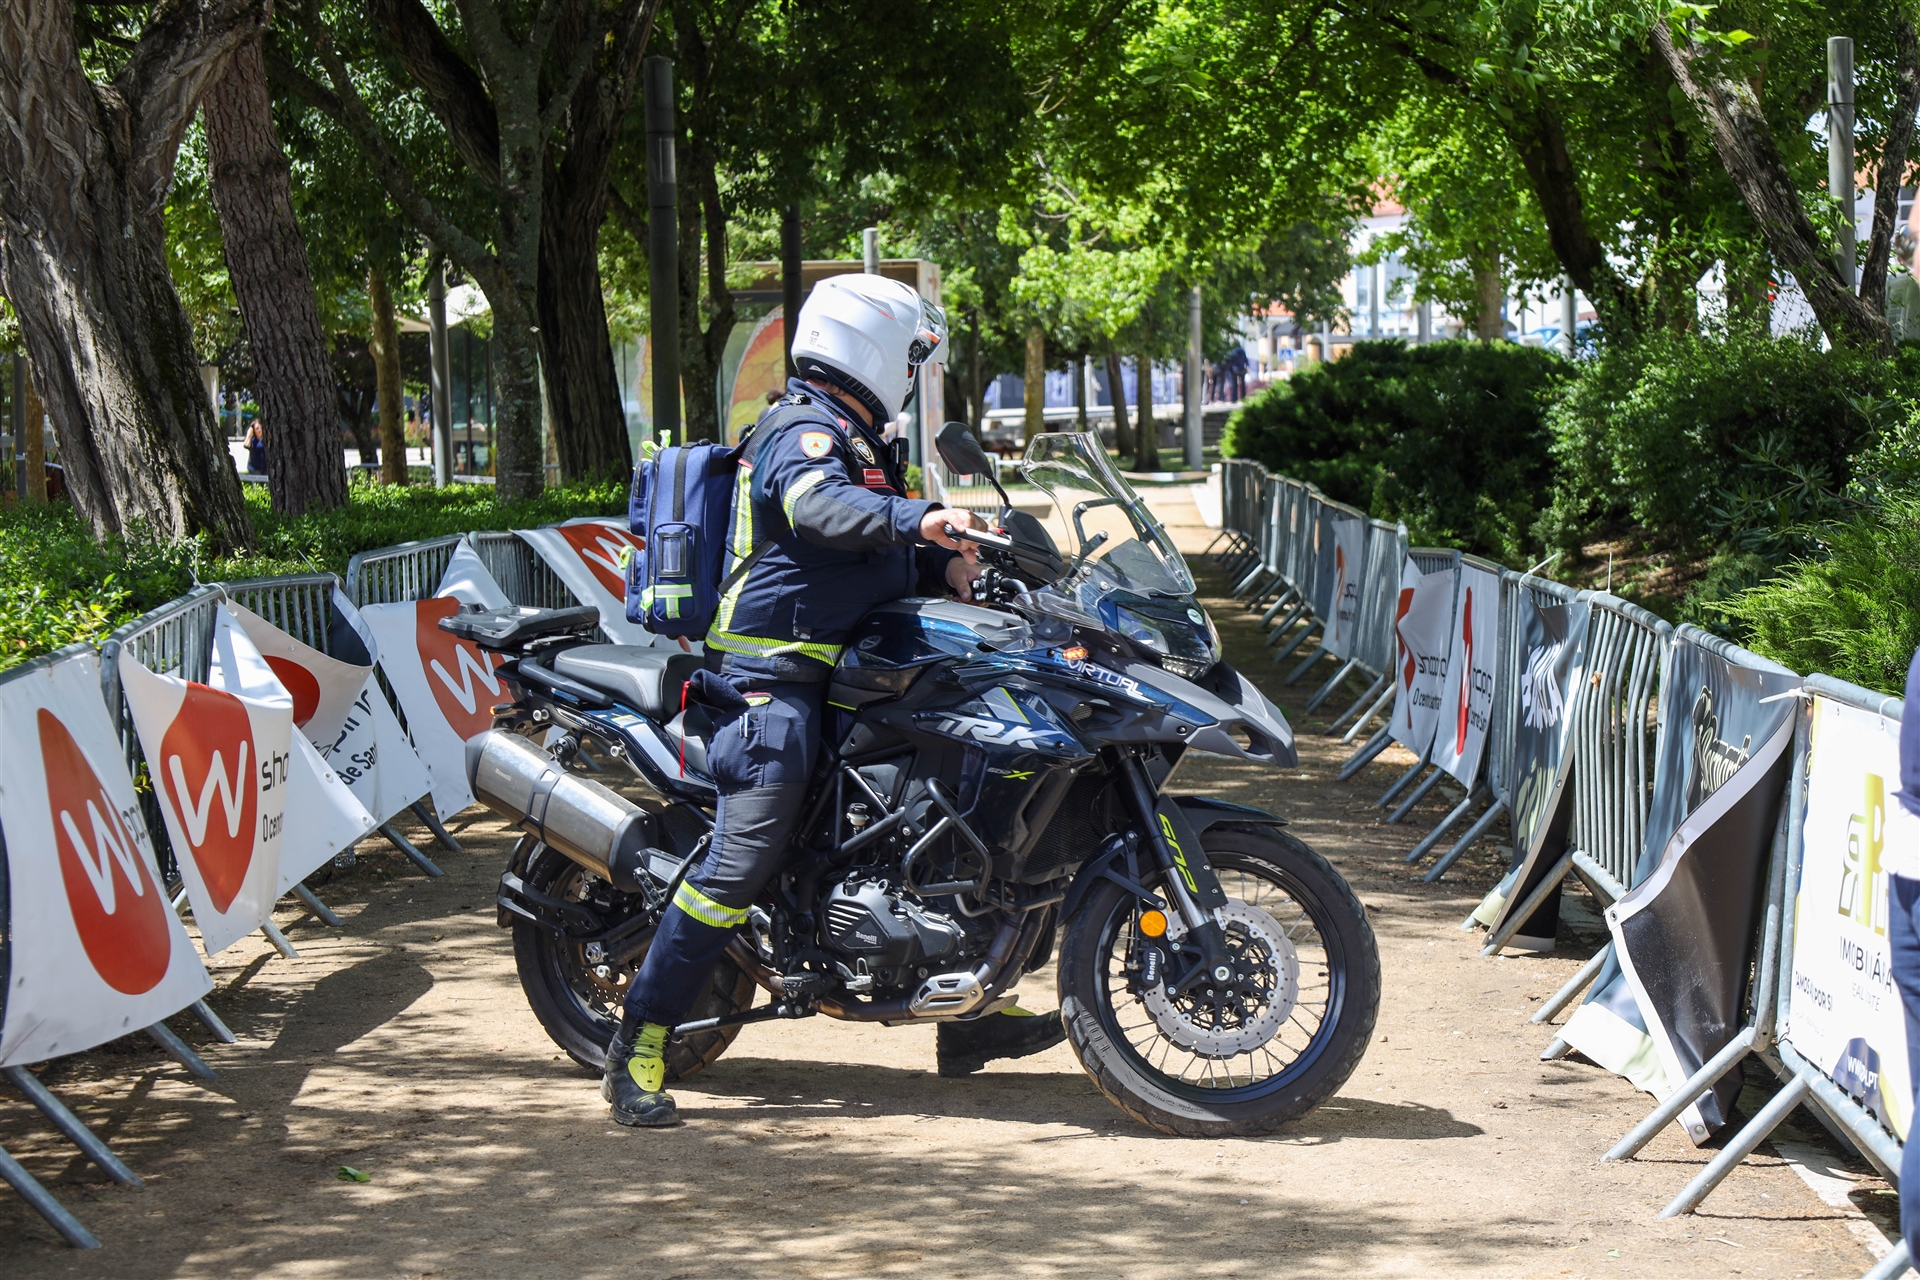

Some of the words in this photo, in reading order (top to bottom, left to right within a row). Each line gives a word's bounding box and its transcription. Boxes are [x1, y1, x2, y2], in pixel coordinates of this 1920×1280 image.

[935, 711, 1063, 751] TRK
[168, 739, 248, 848] W
[335, 769, 356, 786] de
[60, 788, 144, 915] W
[1146, 952, 1157, 981] Benelli
